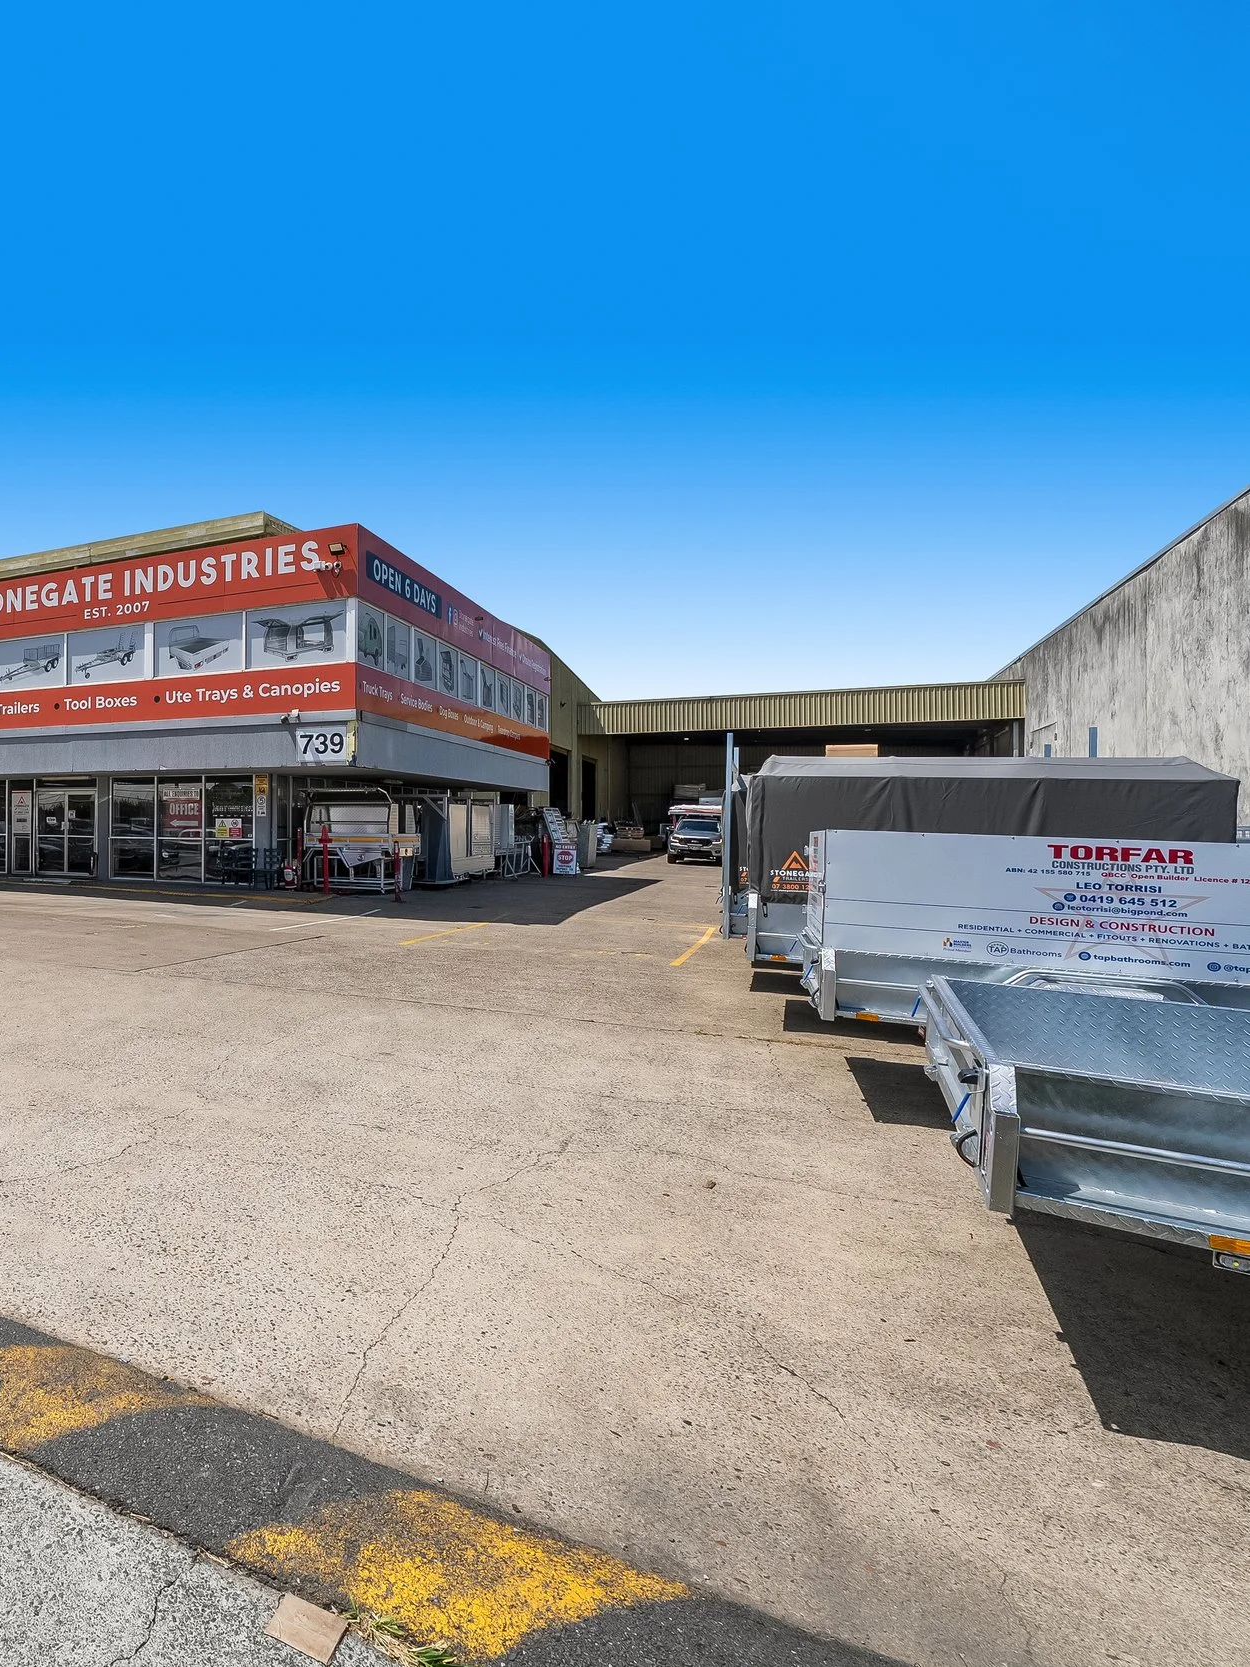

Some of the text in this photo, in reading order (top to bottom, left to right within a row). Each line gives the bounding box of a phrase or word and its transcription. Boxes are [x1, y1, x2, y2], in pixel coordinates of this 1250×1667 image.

[123, 540, 320, 597] INDUSTRIES
[373, 559, 436, 613] OPEN 6 DAYS
[84, 601, 150, 620] EST. 2007
[165, 678, 341, 704] Ute Trays & Canopies
[362, 680, 393, 702] Truck Trays
[64, 695, 138, 710] Tool Boxes
[400, 692, 418, 708] Service
[299, 732, 344, 755] 739
[170, 802, 199, 815] OFFICE
[1047, 844, 1194, 865] TORFAR
[1052, 860, 1195, 875] CONSTRUCTIONS PTY. LTD
[1076, 882, 1162, 893] LEO TORRISI
[1194, 876, 1229, 884] Licence
[1079, 894, 1177, 908] 0419 645 512
[1067, 904, 1188, 918] leotorrisi@bigpond.com
[1030, 916, 1215, 936] DESIGN & CONSTRUCTION
[957, 923, 1014, 933] RESIDENTIAL
[1024, 929, 1086, 938] COMMERCIAL
[1097, 933, 1137, 942] FITOUTS
[1148, 937, 1220, 948] RENOVATIONS
[1010, 947, 1062, 958] Bathrooms
[1093, 954, 1191, 968] tapbathrooms.com
